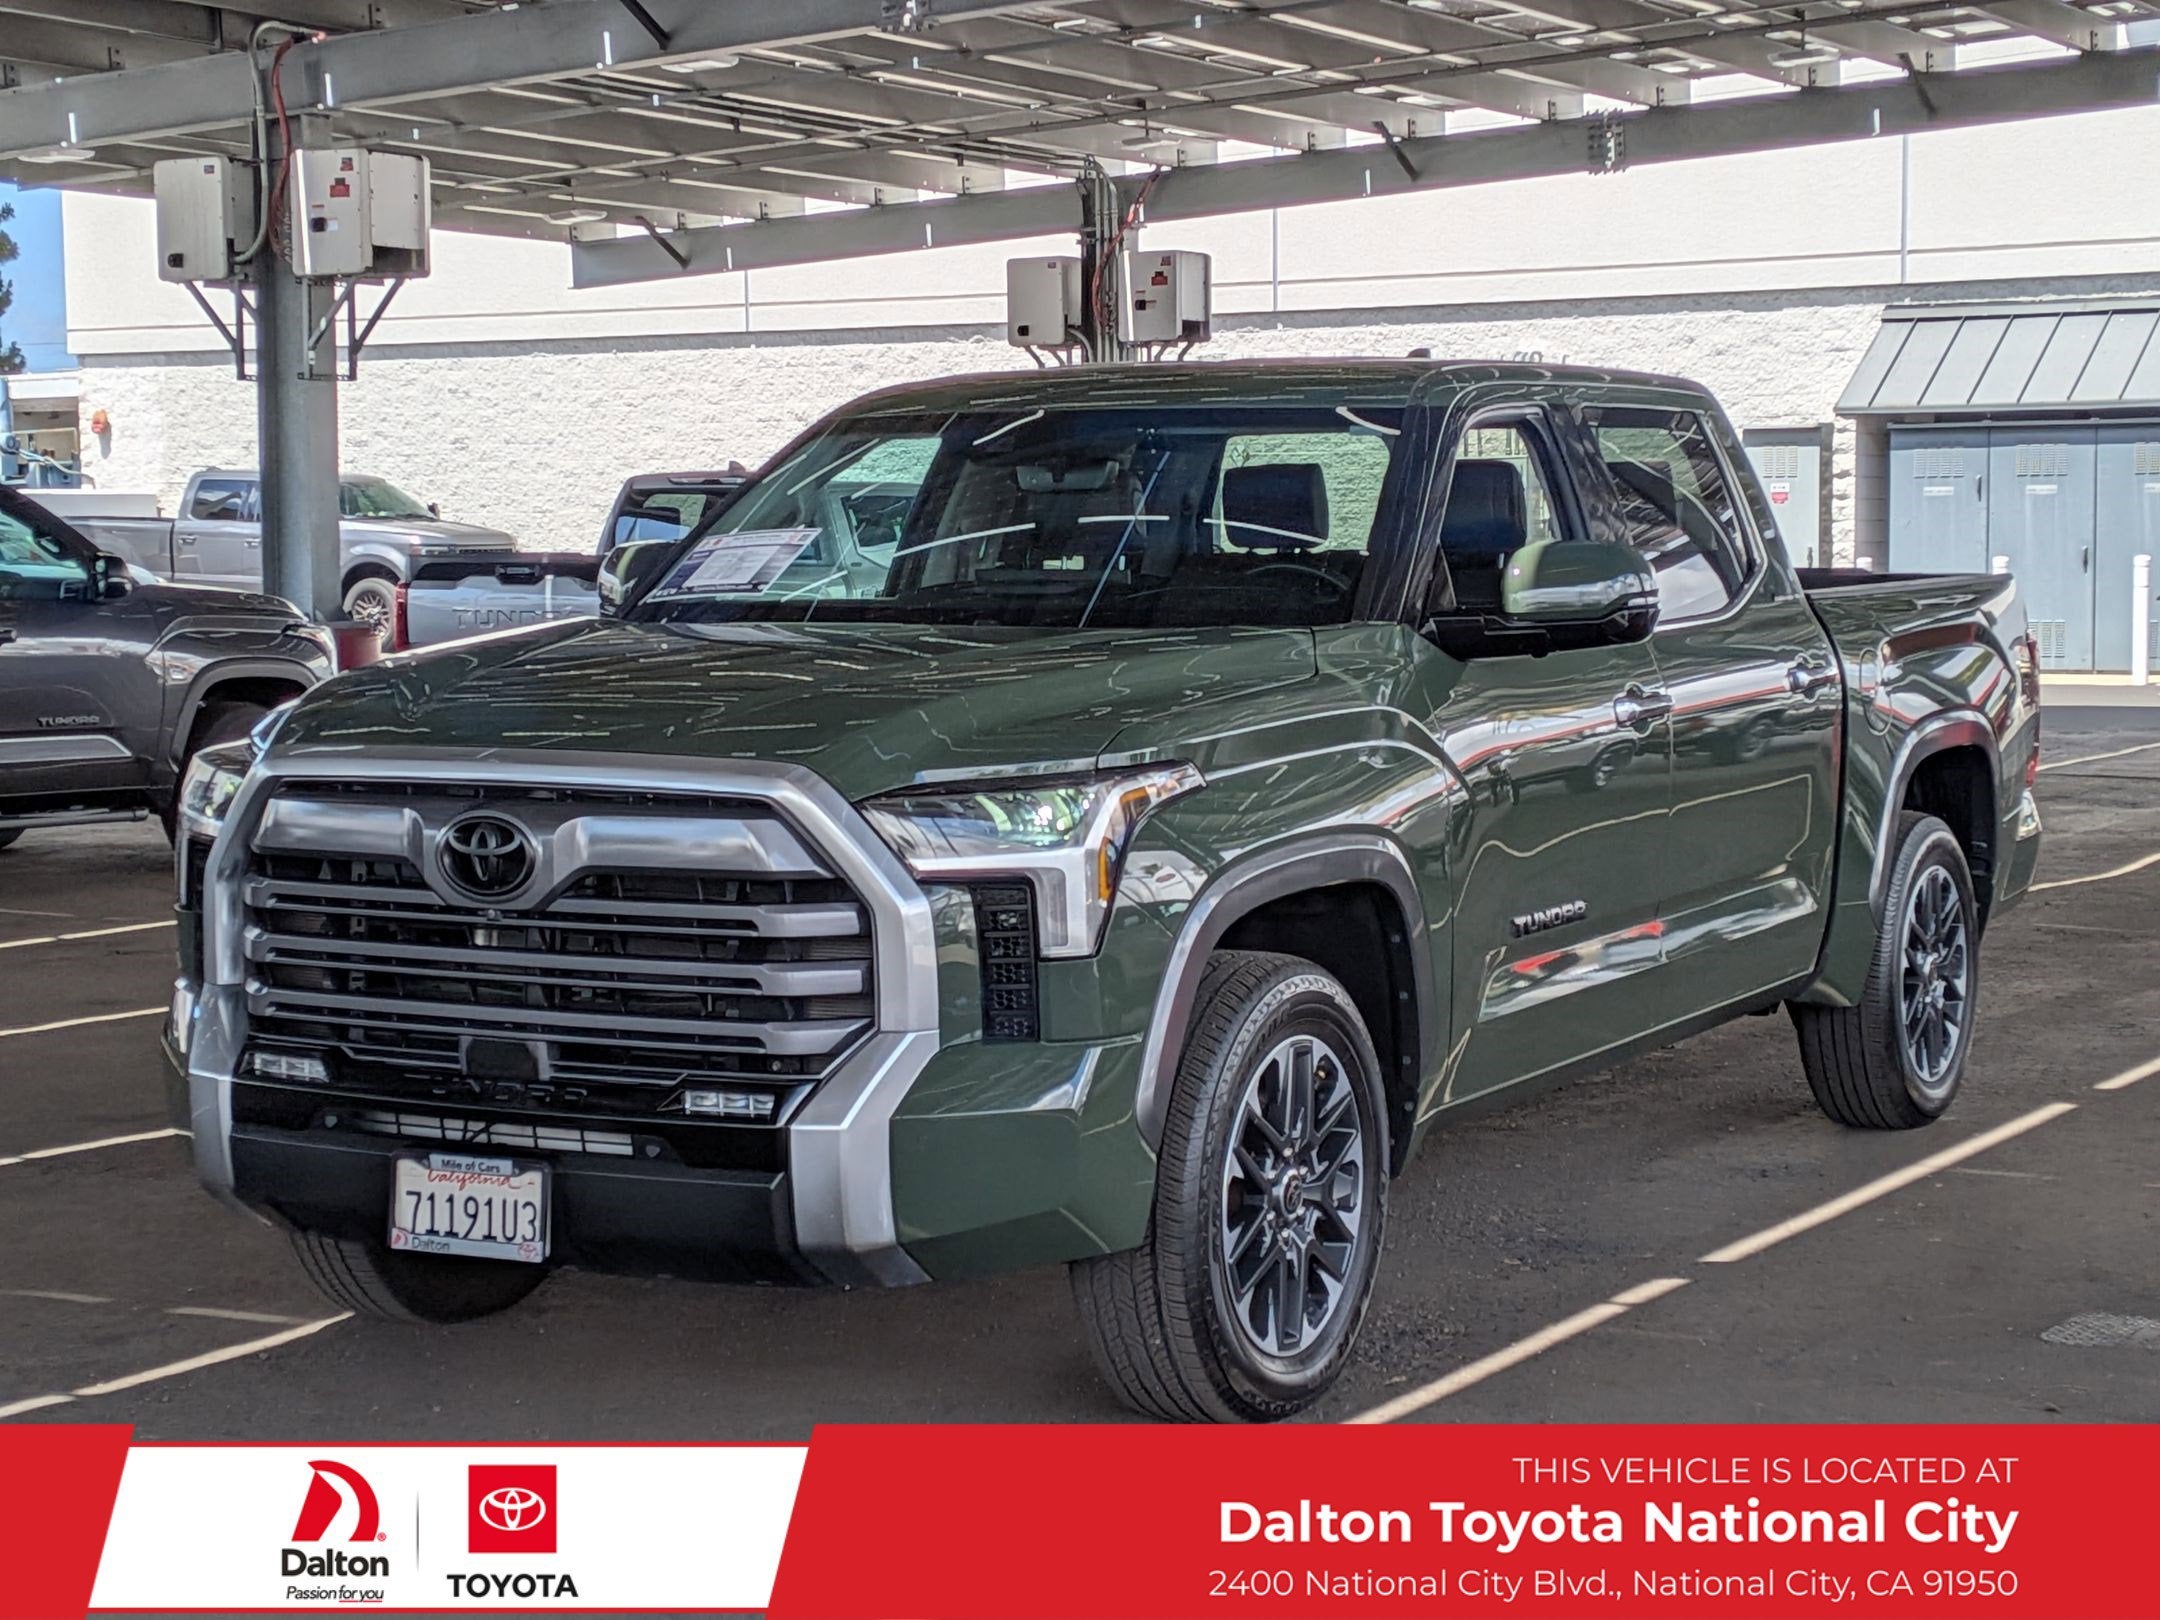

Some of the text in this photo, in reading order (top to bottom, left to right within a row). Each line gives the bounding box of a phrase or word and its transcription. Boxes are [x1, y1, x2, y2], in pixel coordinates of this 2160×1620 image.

[1512, 900, 1587, 938] TUNDRA
[441, 1159, 501, 1174] Mile of Cars
[406, 1190, 538, 1244] 71191U3
[411, 1236, 451, 1253] Dalton
